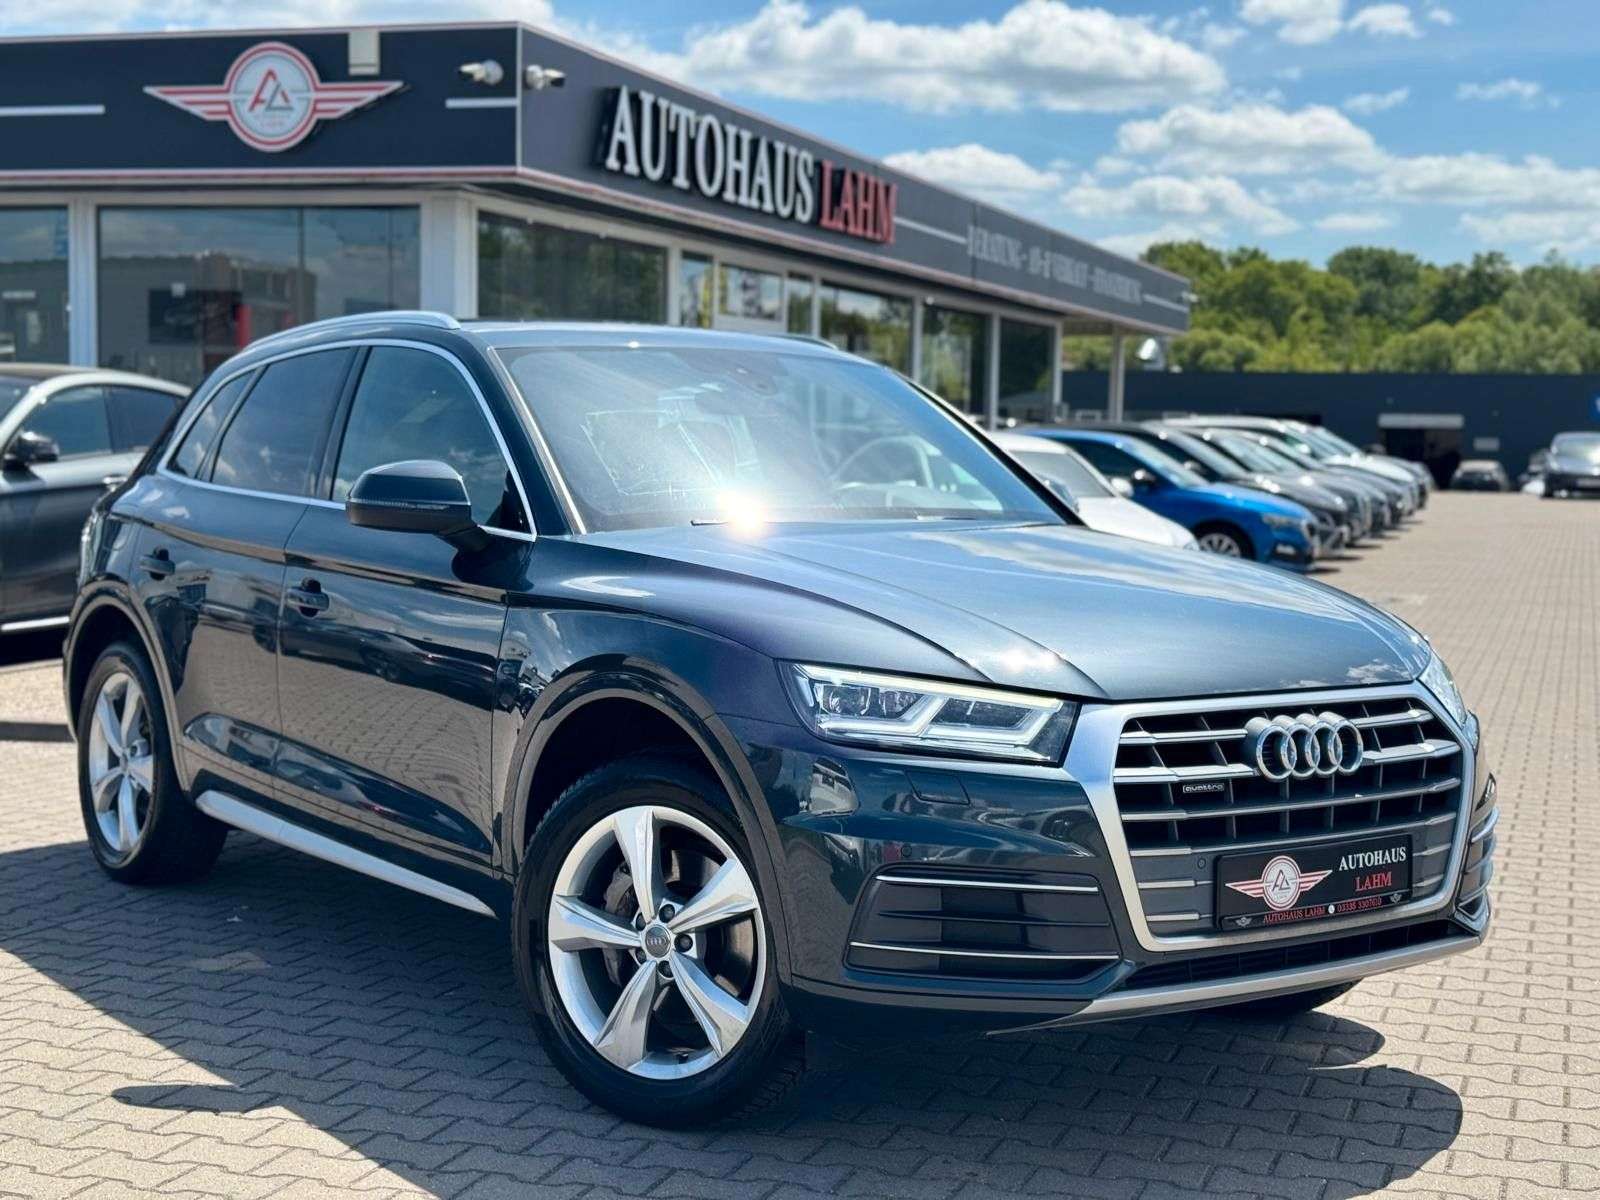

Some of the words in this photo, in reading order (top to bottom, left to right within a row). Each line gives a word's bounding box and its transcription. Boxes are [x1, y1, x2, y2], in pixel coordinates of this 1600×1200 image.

[605, 84, 814, 223] AUTOHAUS
[819, 159, 898, 243] LAHM
[1185, 784, 1223, 792] quattro
[1339, 847, 1407, 871] AUTOHAUS
[1355, 872, 1392, 892] LAHM
[1263, 910, 1303, 924] AUTOHAUS
[1305, 906, 1326, 917] LAHM
